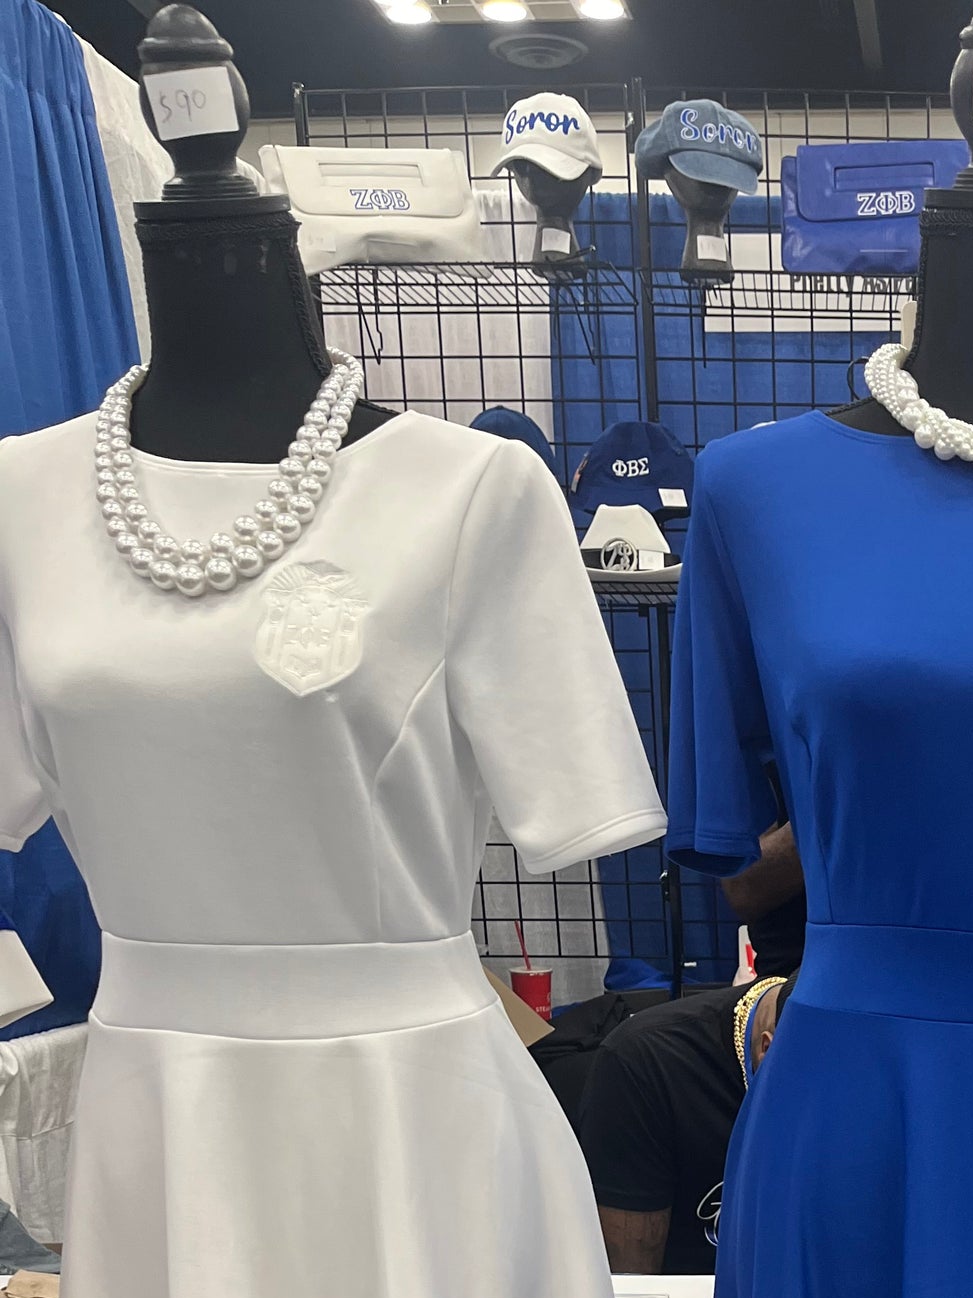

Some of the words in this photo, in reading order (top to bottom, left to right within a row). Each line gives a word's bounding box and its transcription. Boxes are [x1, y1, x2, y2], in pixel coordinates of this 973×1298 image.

[159, 87, 207, 124] $90
[505, 109, 580, 145] Soror
[680, 108, 757, 153] Soror
[611, 457, 650, 477] ΦΒΣ
